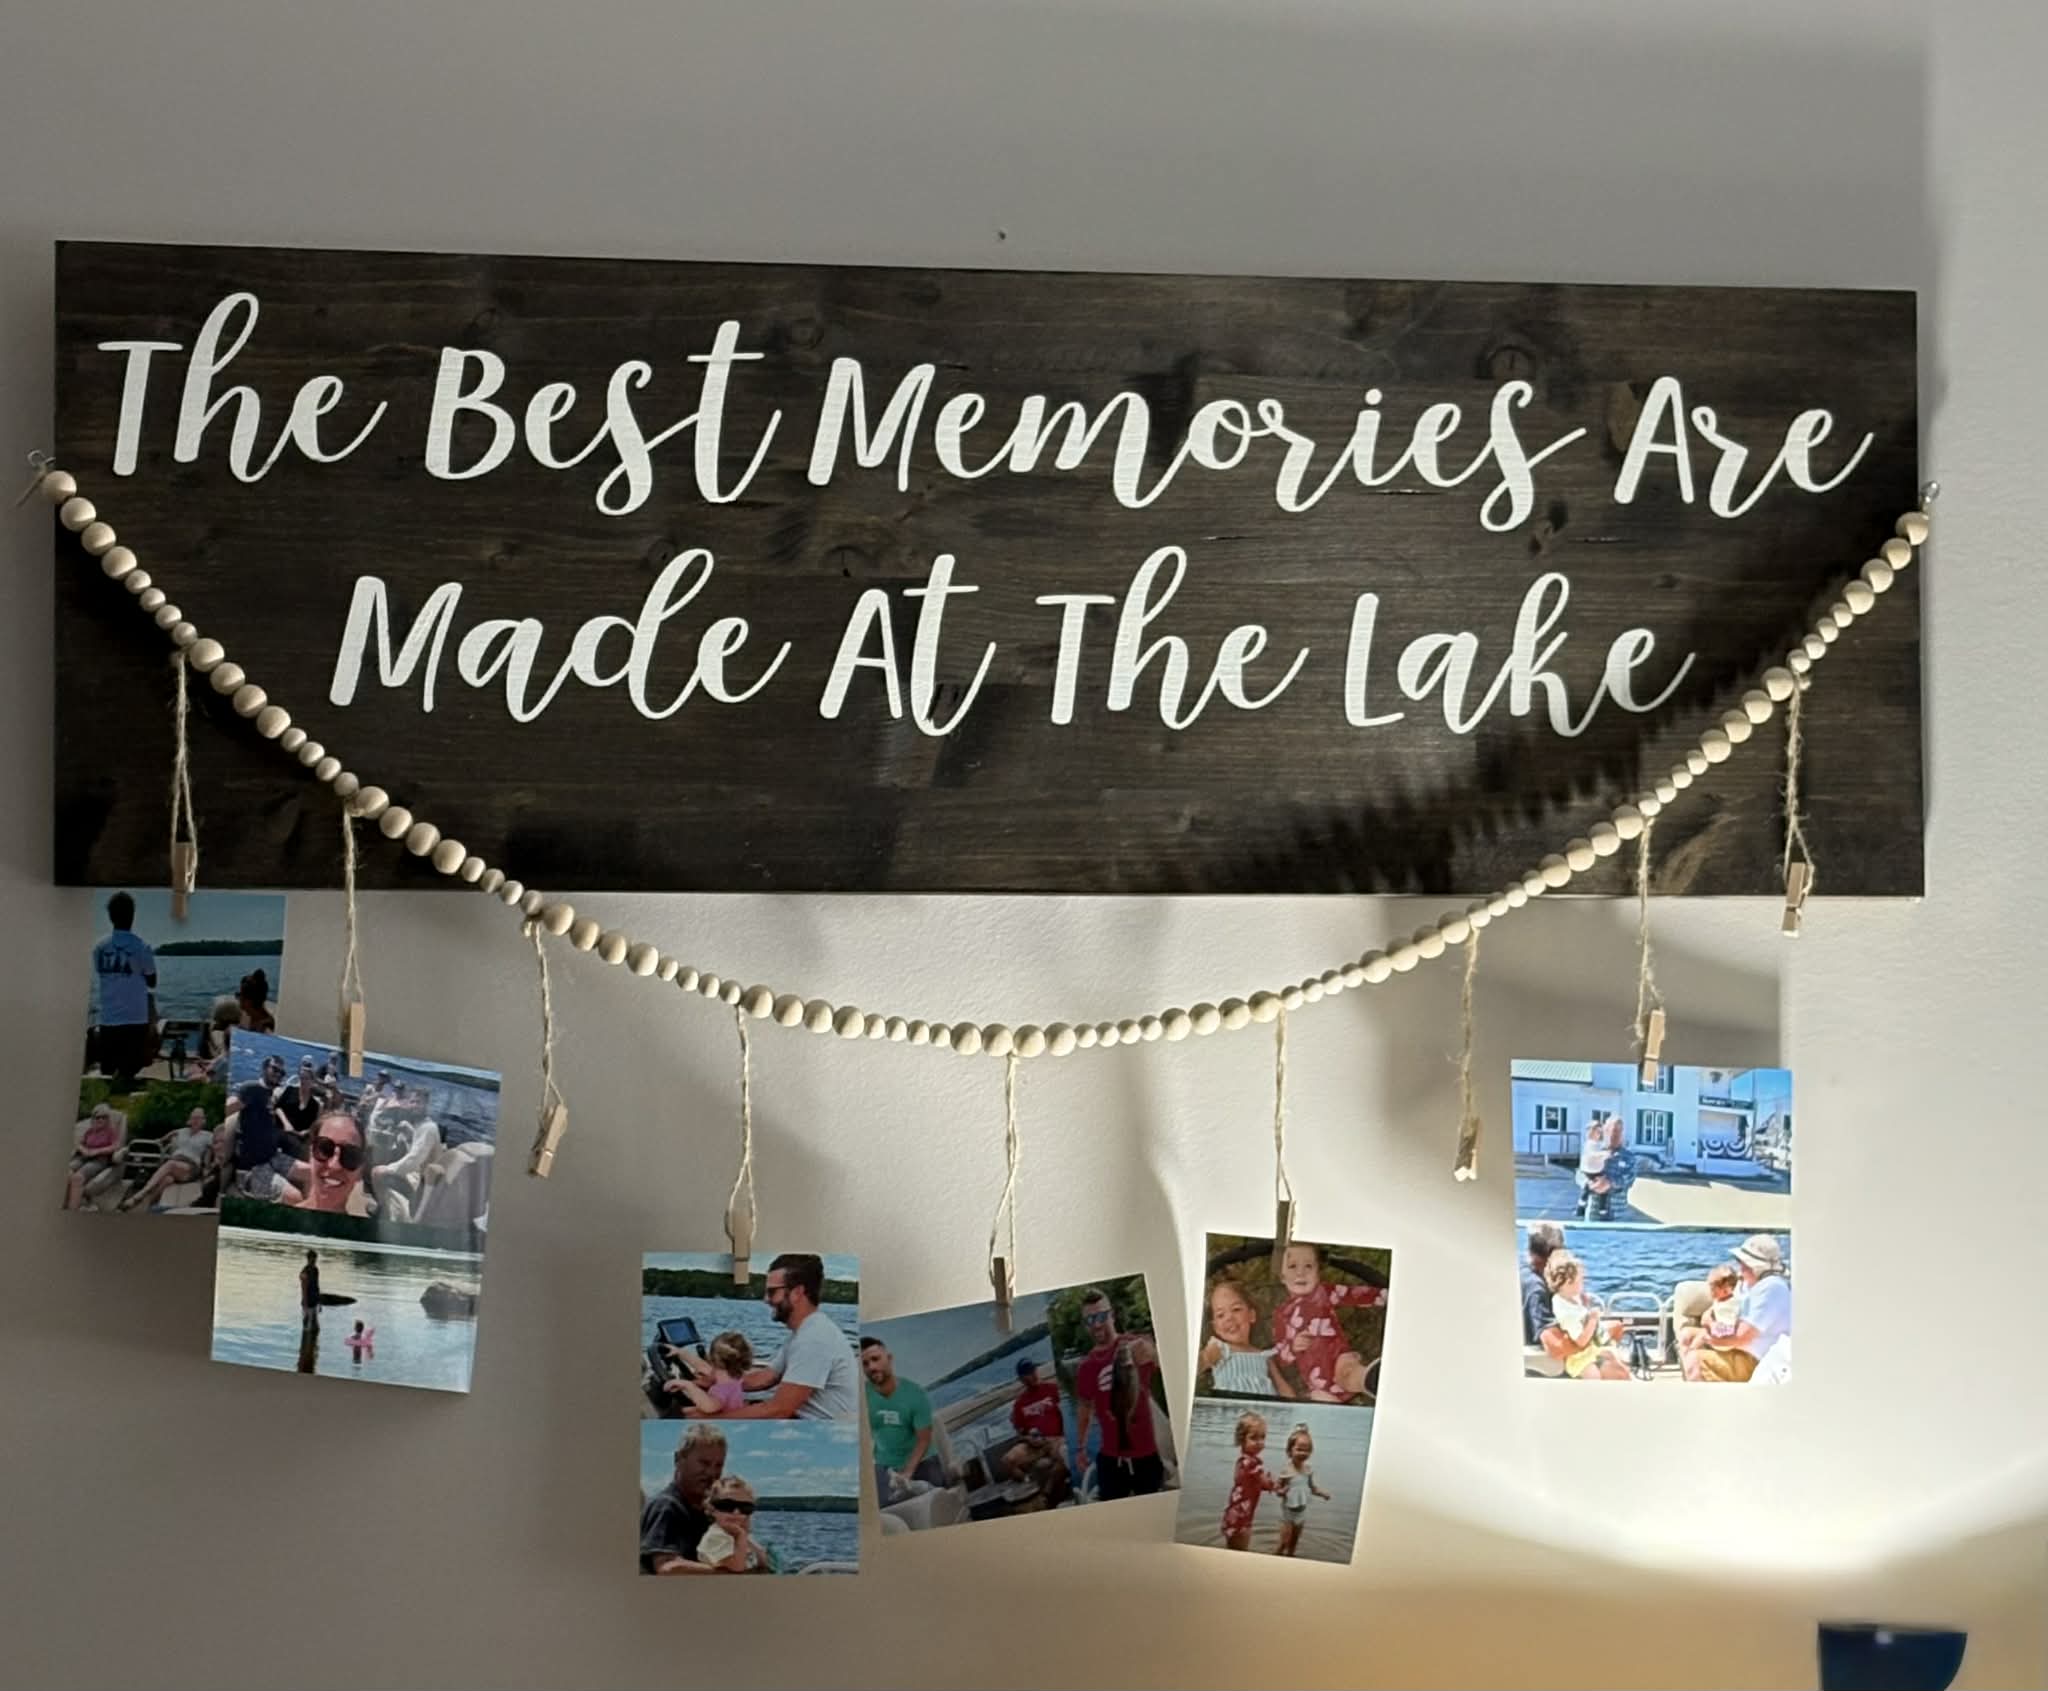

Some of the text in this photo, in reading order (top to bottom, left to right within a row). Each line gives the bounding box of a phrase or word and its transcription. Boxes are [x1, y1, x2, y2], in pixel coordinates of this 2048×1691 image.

[99, 292, 1874, 533] The Best Memories Are
[329, 545, 1696, 738] Made At The Lake
